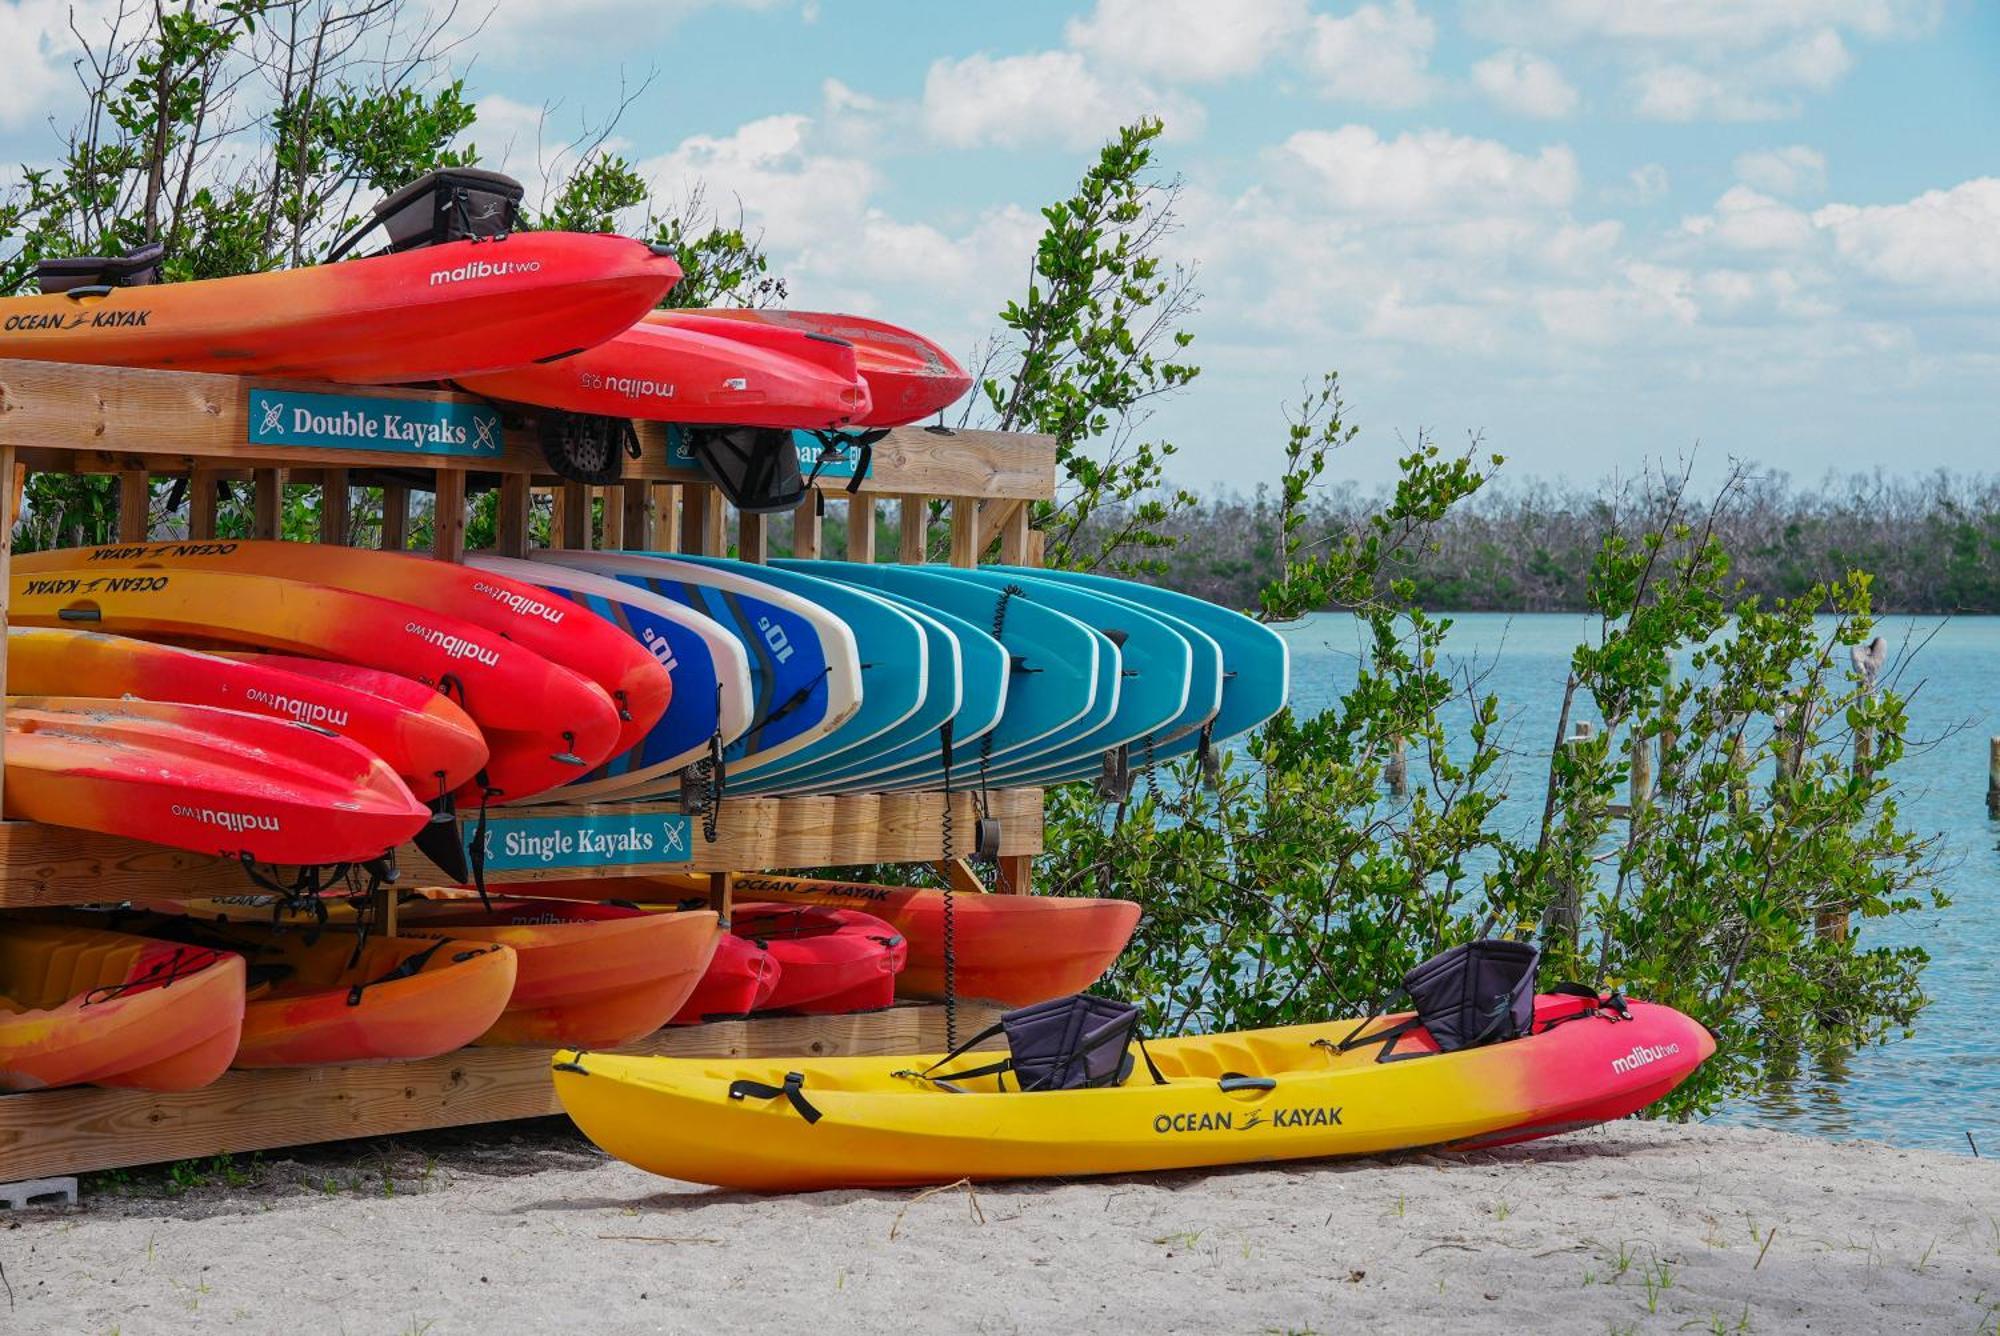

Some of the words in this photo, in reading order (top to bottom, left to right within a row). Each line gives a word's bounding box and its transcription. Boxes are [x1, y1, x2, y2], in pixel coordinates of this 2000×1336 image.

[4, 312, 66, 331] OCEAN
[91, 309, 152, 327] KAYAK
[604, 375, 675, 398] malibu
[293, 408, 378, 438] Double
[383, 415, 467, 448] Kayaks
[88, 547, 150, 561] KAYAK
[172, 543, 238, 556] OCEAN
[21, 580, 81, 596] KAYAK
[106, 576, 169, 593] OCEAN
[505, 829, 574, 862] Single
[577, 826, 654, 858] Kayaks
[733, 879, 800, 892] OCEAN
[826, 884, 893, 901] KAYAK
[1153, 1111, 1233, 1134] OCEAN
[1273, 1106, 1344, 1128] KAYAK
